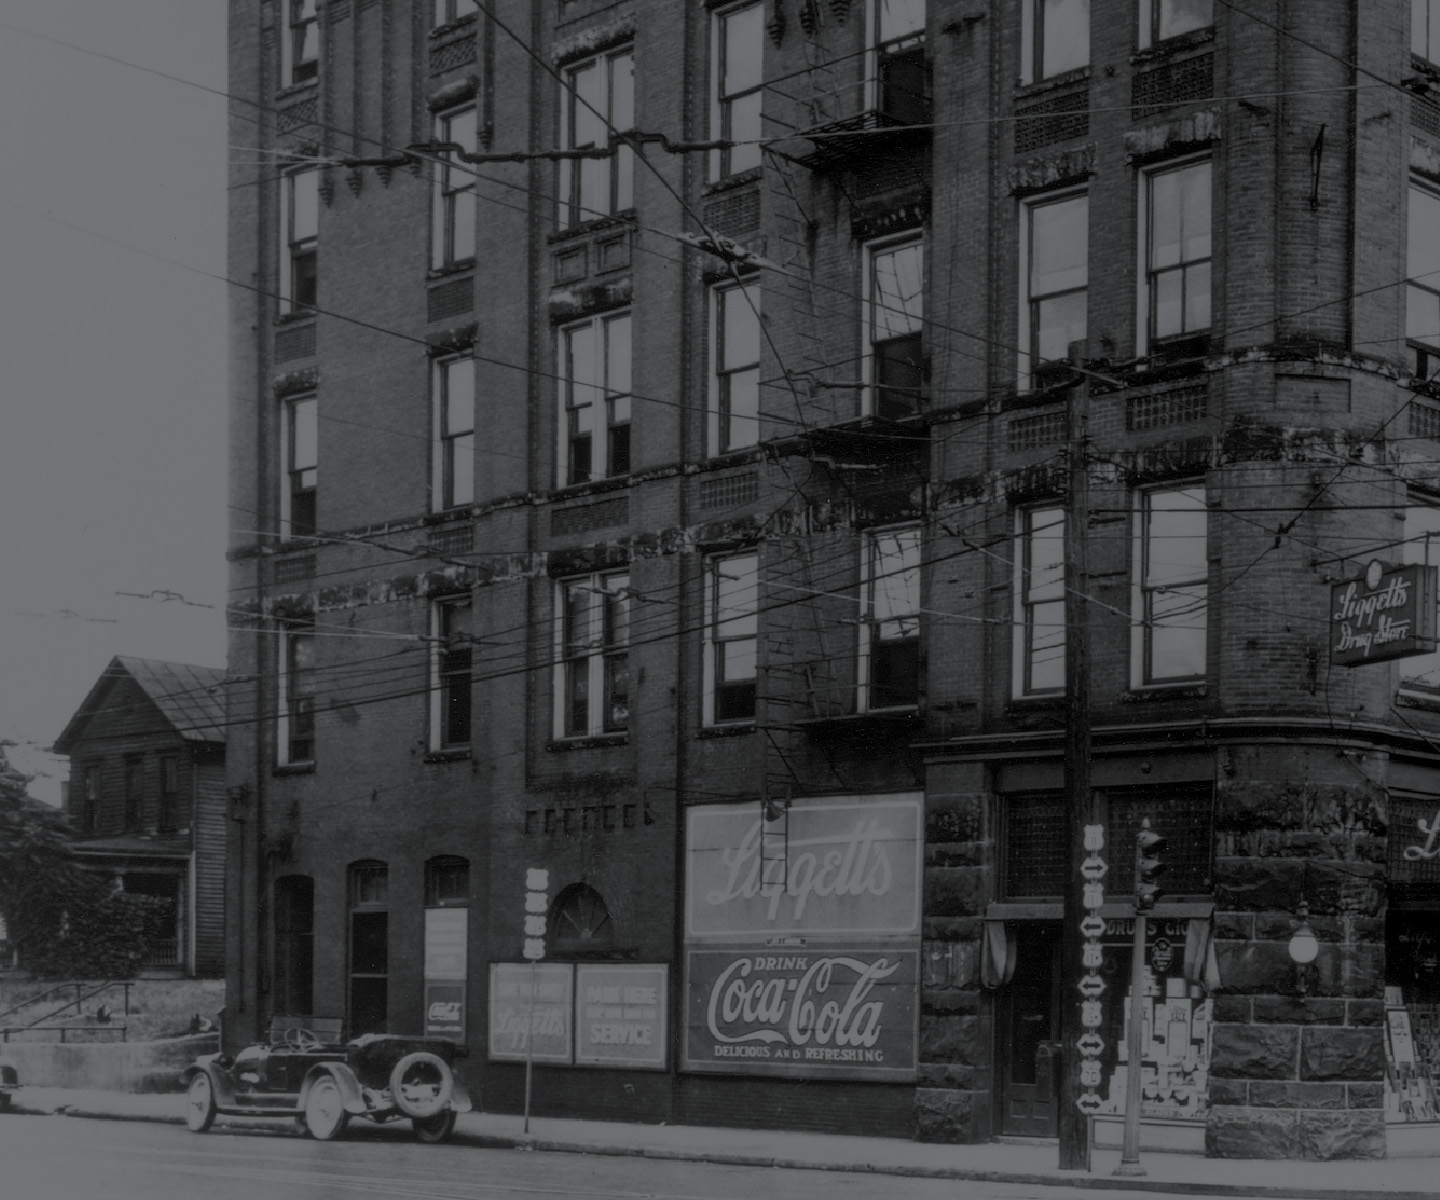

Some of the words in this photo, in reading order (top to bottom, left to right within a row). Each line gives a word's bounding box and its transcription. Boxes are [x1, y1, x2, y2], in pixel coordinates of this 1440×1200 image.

[1334, 621, 1372, 657] Drug
[706, 817, 896, 921] Liggett's
[1105, 919, 1157, 935] DRUS
[754, 957, 808, 971] DRINK
[708, 957, 903, 1048] Coca-Cola
[590, 1023, 652, 1045] SERVICE
[714, 1045, 770, 1057] DELICIOUS
[774, 1049, 801, 1060] AND
[805, 1047, 884, 1062] REFRESHING
